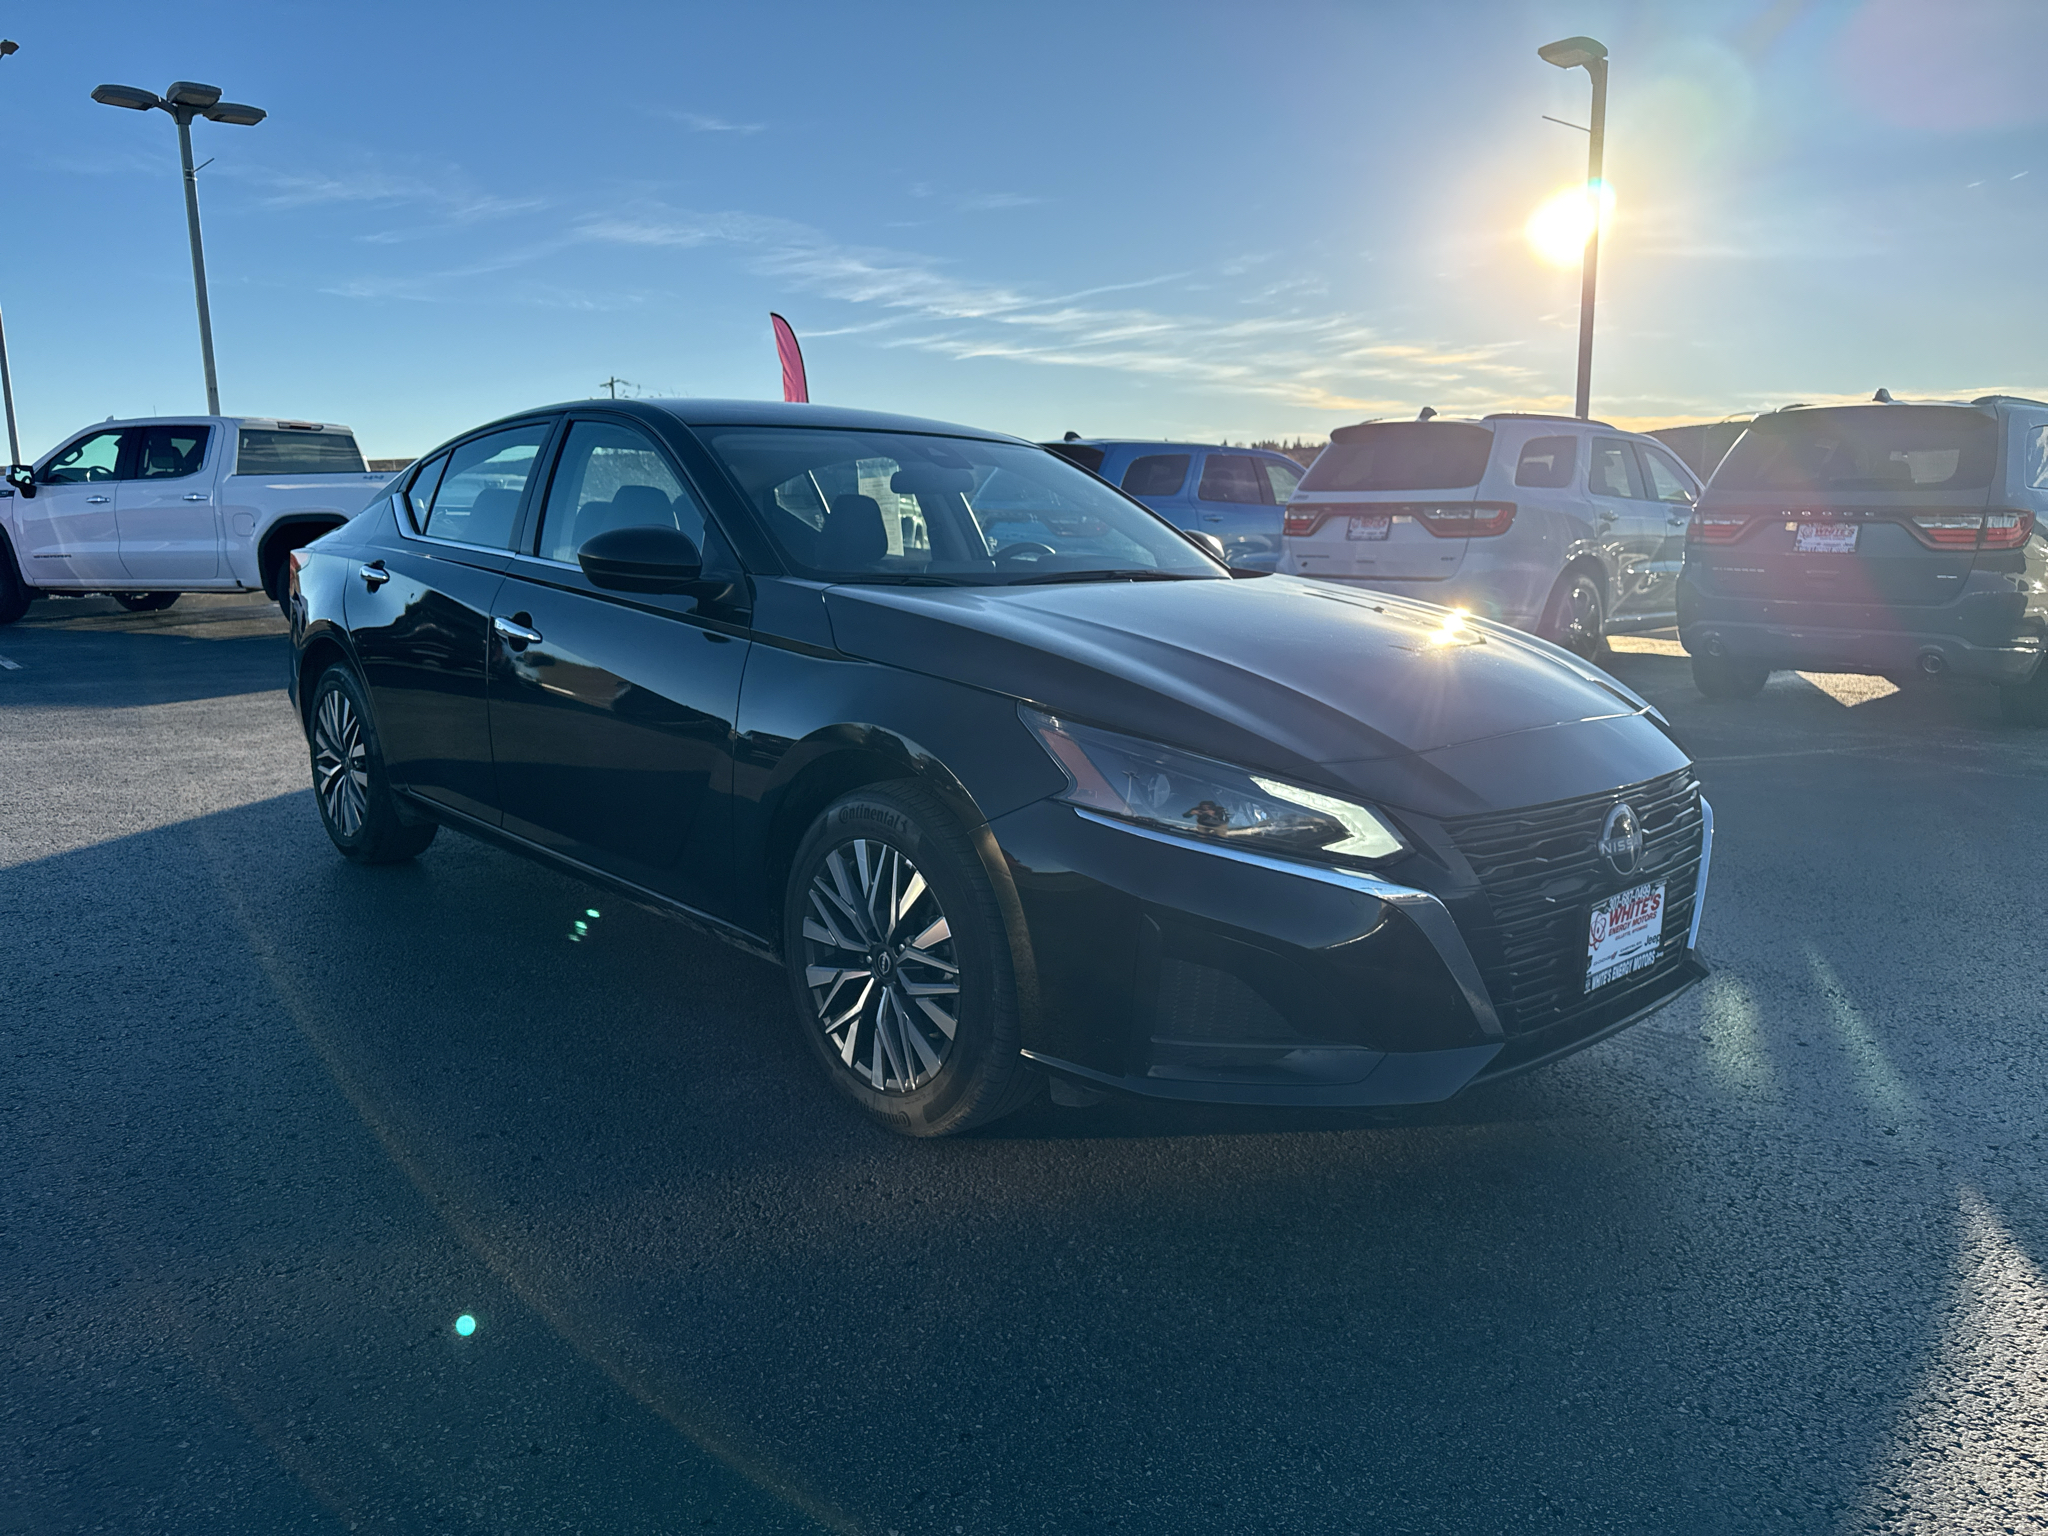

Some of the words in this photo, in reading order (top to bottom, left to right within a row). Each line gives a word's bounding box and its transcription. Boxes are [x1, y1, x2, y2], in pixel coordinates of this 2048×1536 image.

[838, 803, 901, 829] Continental
[1601, 834, 1642, 855] NISSA
[1608, 920, 1631, 937] ENERGY
[1631, 910, 1657, 927] MOTORS
[1609, 893, 1661, 928] WHITE'S
[1644, 933, 1661, 946] Jeep
